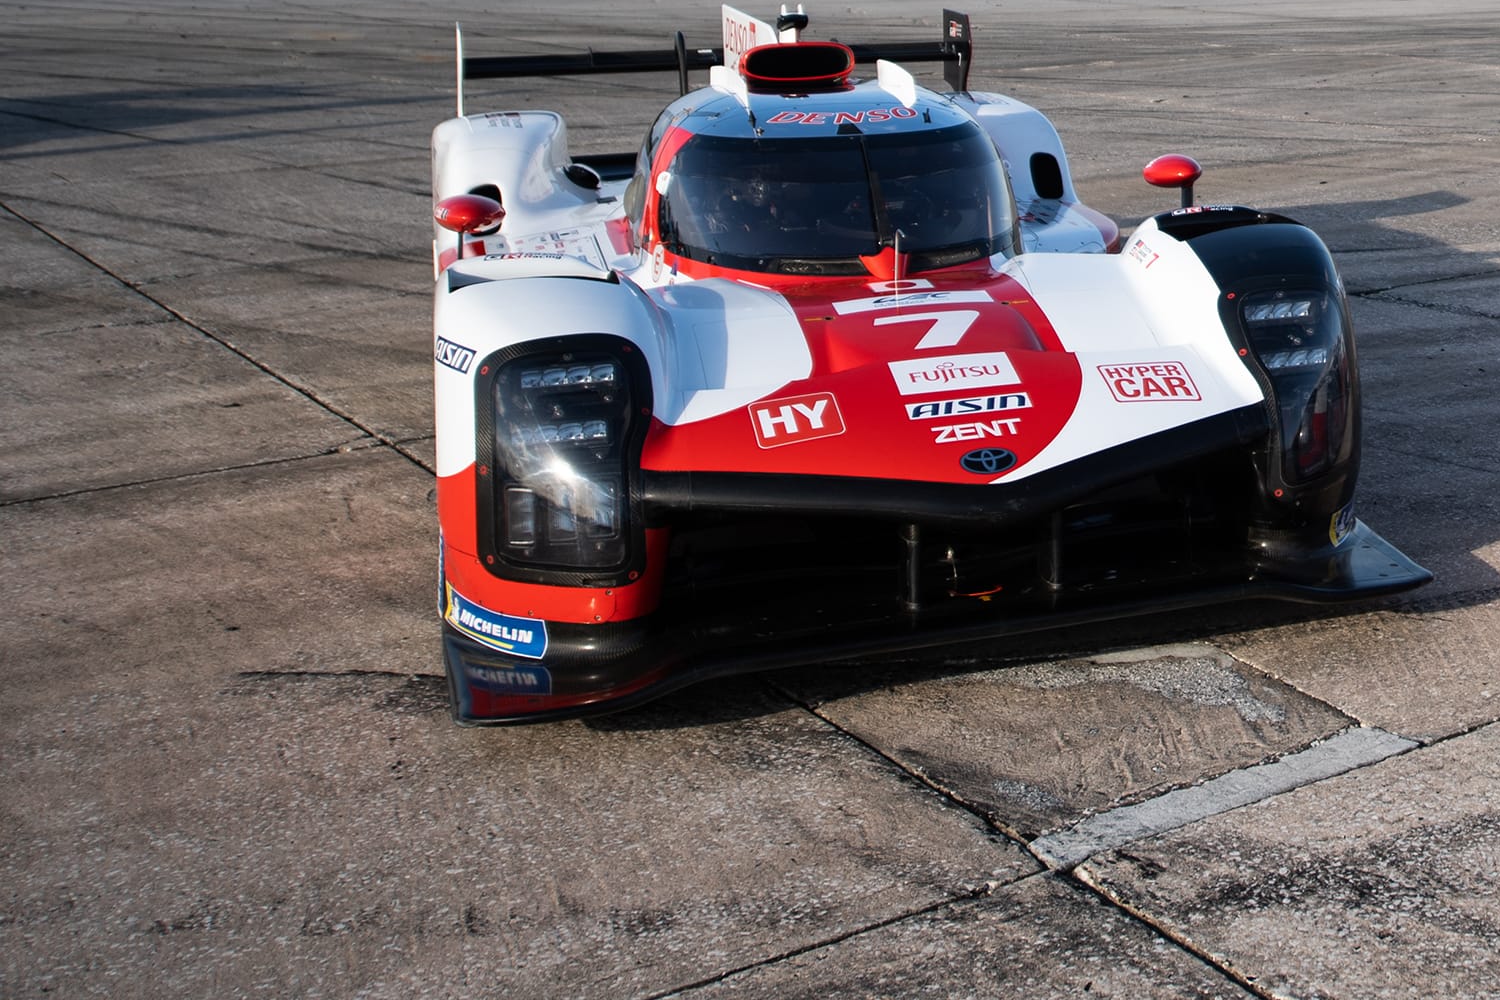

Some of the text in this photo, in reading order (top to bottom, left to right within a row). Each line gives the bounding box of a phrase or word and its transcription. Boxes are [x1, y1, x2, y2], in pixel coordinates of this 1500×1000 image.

[766, 106, 918, 125] DENSO
[873, 310, 980, 351] 7
[908, 362, 1000, 383] FUJITSU
[1104, 364, 1182, 379] HYPER
[1113, 376, 1194, 398] CAR
[911, 394, 1026, 418] AISIN
[756, 399, 828, 439] HY
[930, 418, 1022, 444] ZENT
[459, 608, 534, 644] MICHELIN
